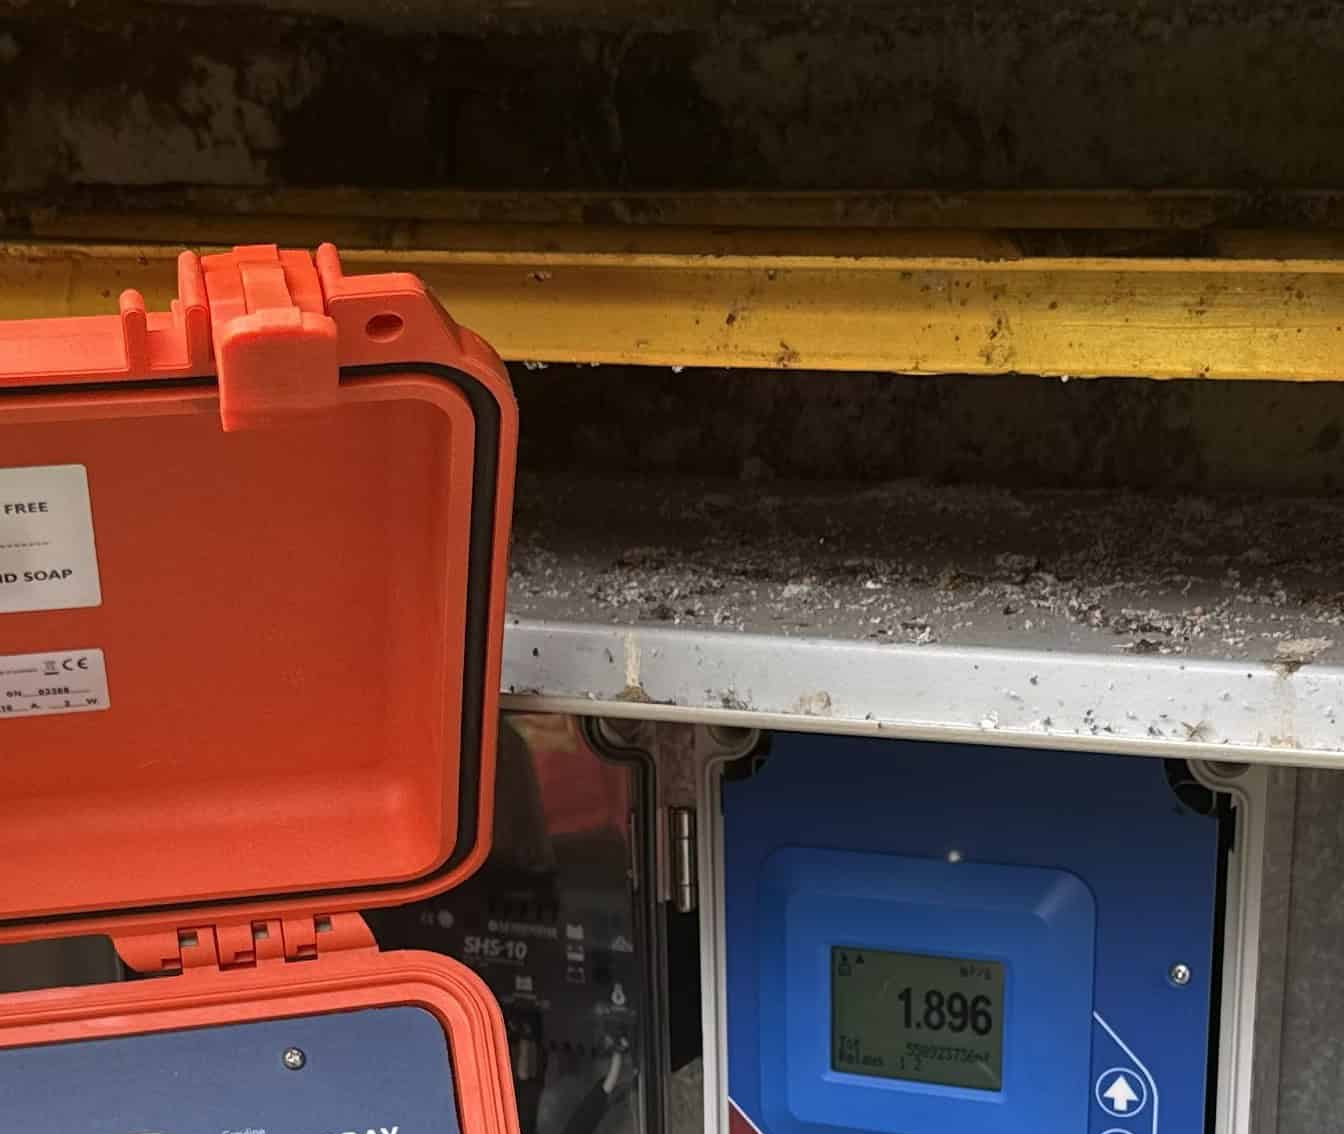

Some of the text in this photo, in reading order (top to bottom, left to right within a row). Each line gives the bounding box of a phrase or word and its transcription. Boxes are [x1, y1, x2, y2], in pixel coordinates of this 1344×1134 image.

[3, 501, 50, 515] FREE
[23, 567, 74, 583] SOAP
[897, 986, 994, 1037] 1.896
